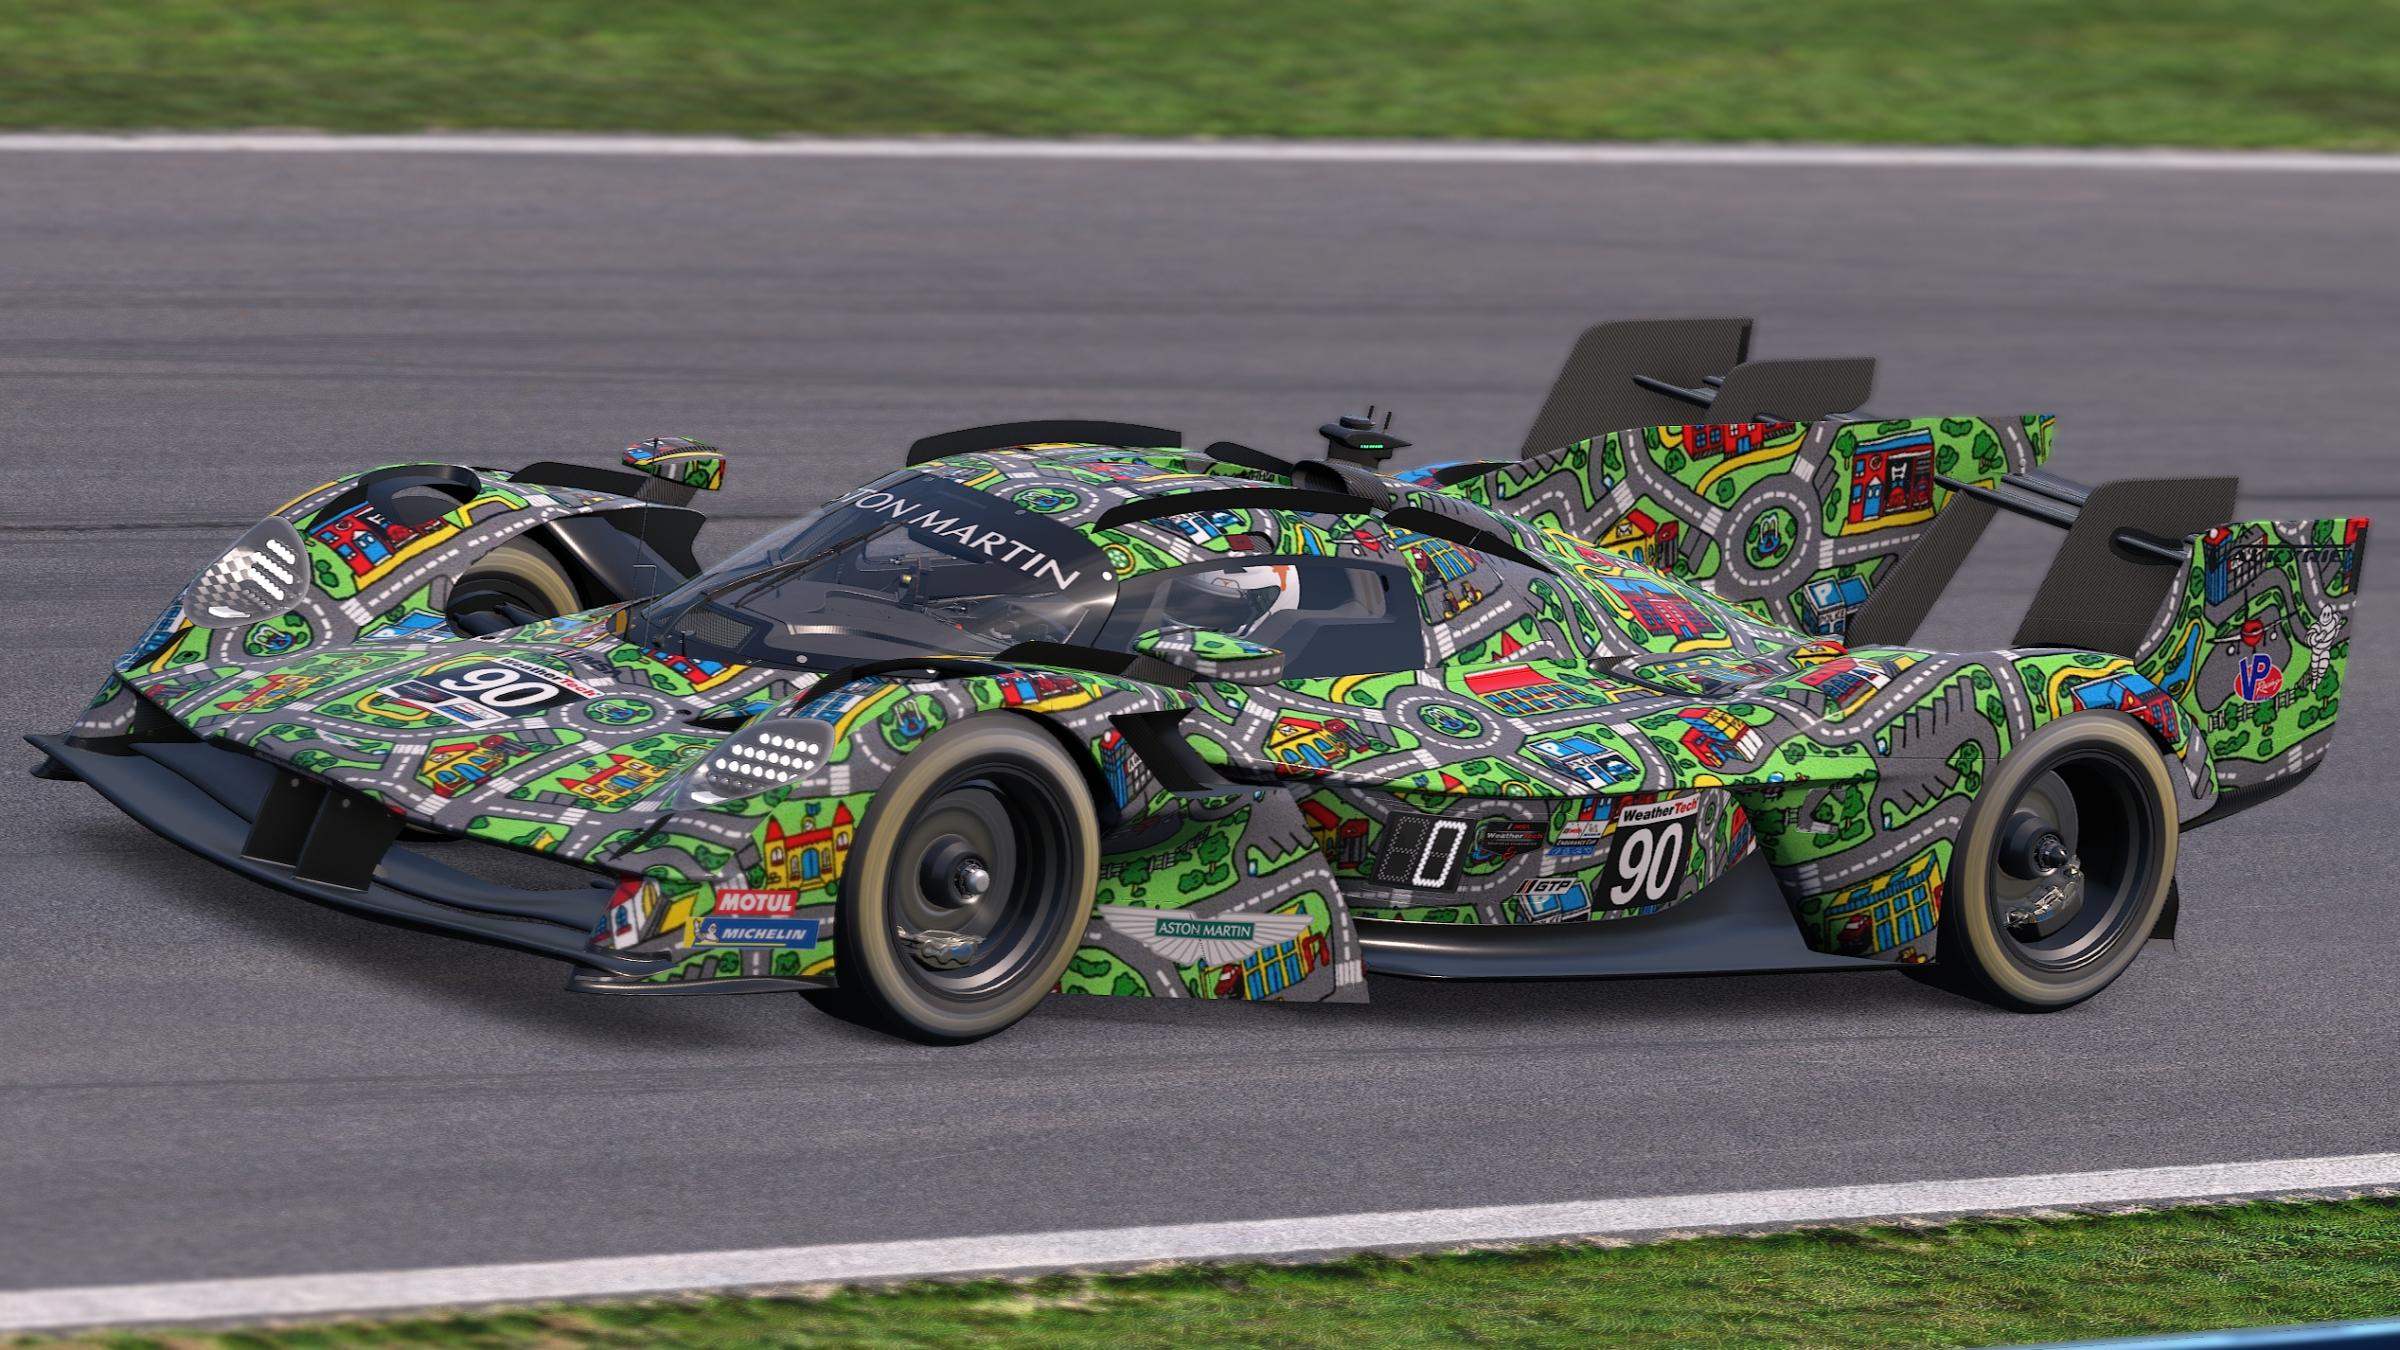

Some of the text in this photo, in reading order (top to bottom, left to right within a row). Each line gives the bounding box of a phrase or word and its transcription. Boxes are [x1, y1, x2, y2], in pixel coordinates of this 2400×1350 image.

[909, 510, 1080, 590] MARTIN
[439, 668, 559, 707] 90
[501, 657, 598, 697] WeatherTech
[2239, 653, 2272, 702] VP
[1623, 799, 1699, 822] WeatherTech
[1486, 832, 1544, 840] WeatherTech
[1610, 822, 1683, 905] 90
[1534, 881, 1572, 892] GTP
[718, 893, 792, 912] MOTUL
[722, 928, 807, 940] MICHELIN
[1158, 922, 1252, 937] ASTON MARTIN
